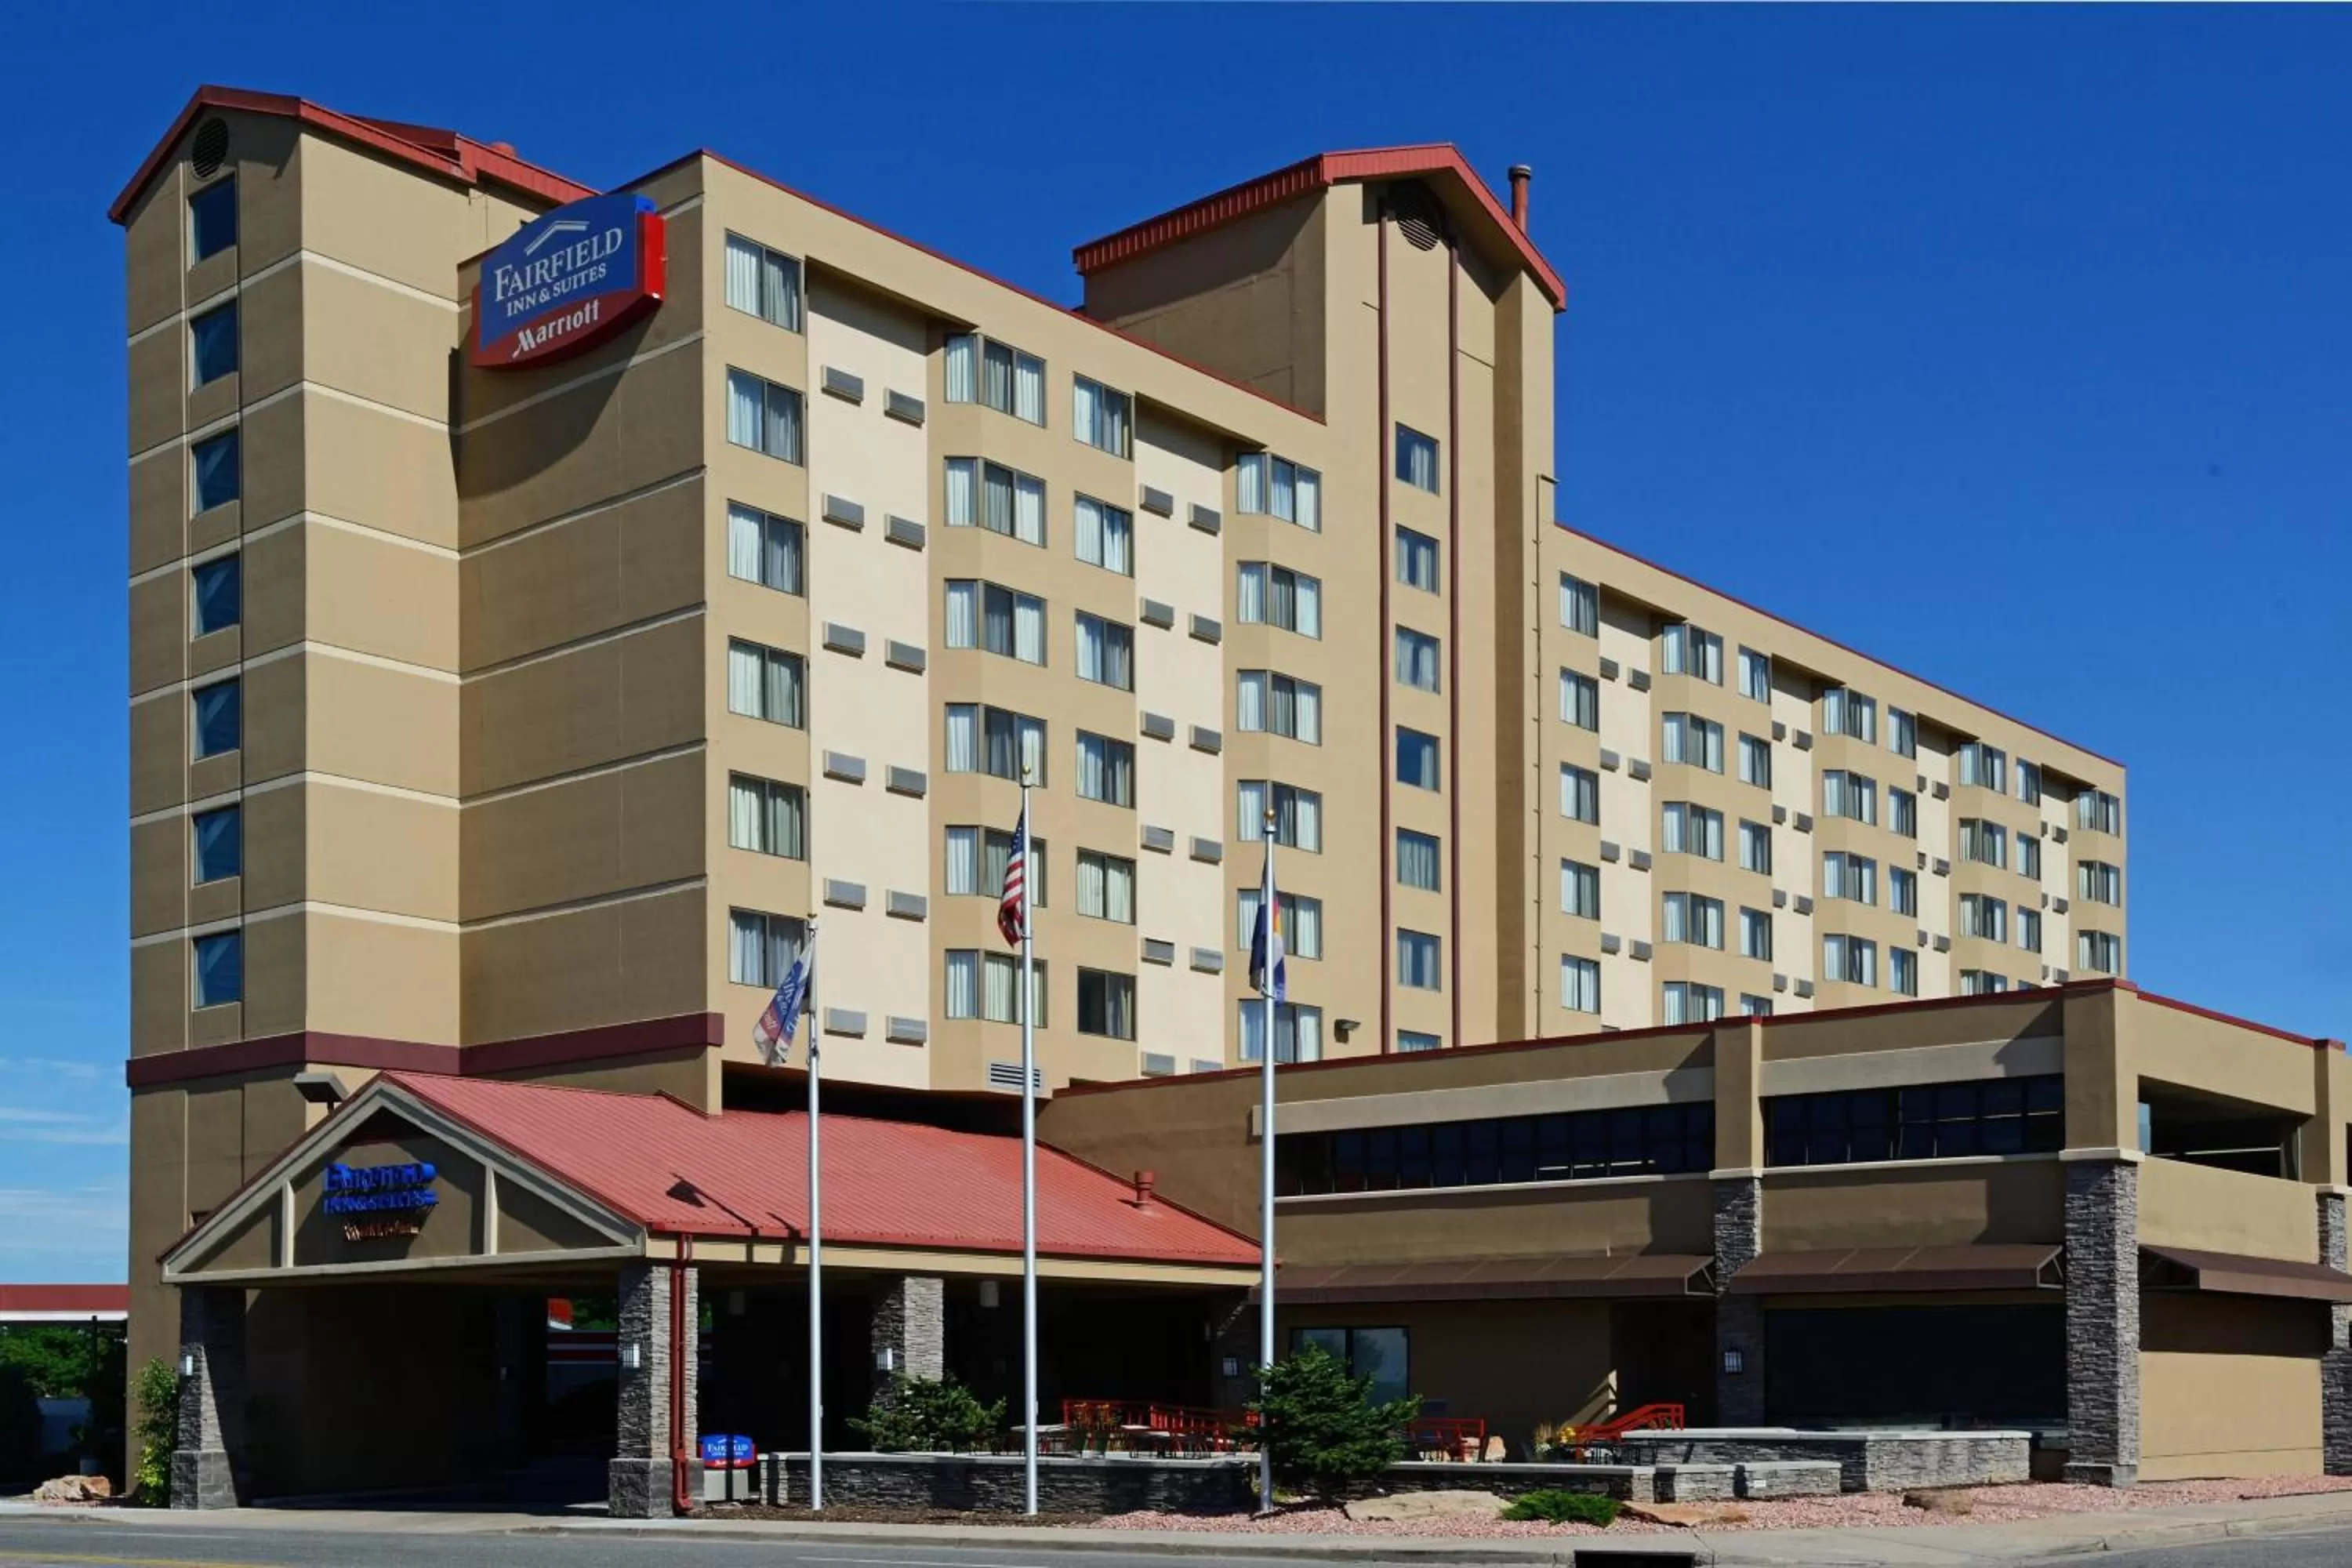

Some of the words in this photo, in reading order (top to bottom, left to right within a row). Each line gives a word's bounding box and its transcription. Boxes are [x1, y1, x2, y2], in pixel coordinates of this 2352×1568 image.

[493, 227, 623, 302] FAIRFIELD
[506, 289, 537, 317] INN
[539, 288, 552, 303] &
[552, 263, 607, 297] SUITES
[512, 299, 601, 358] Marriott
